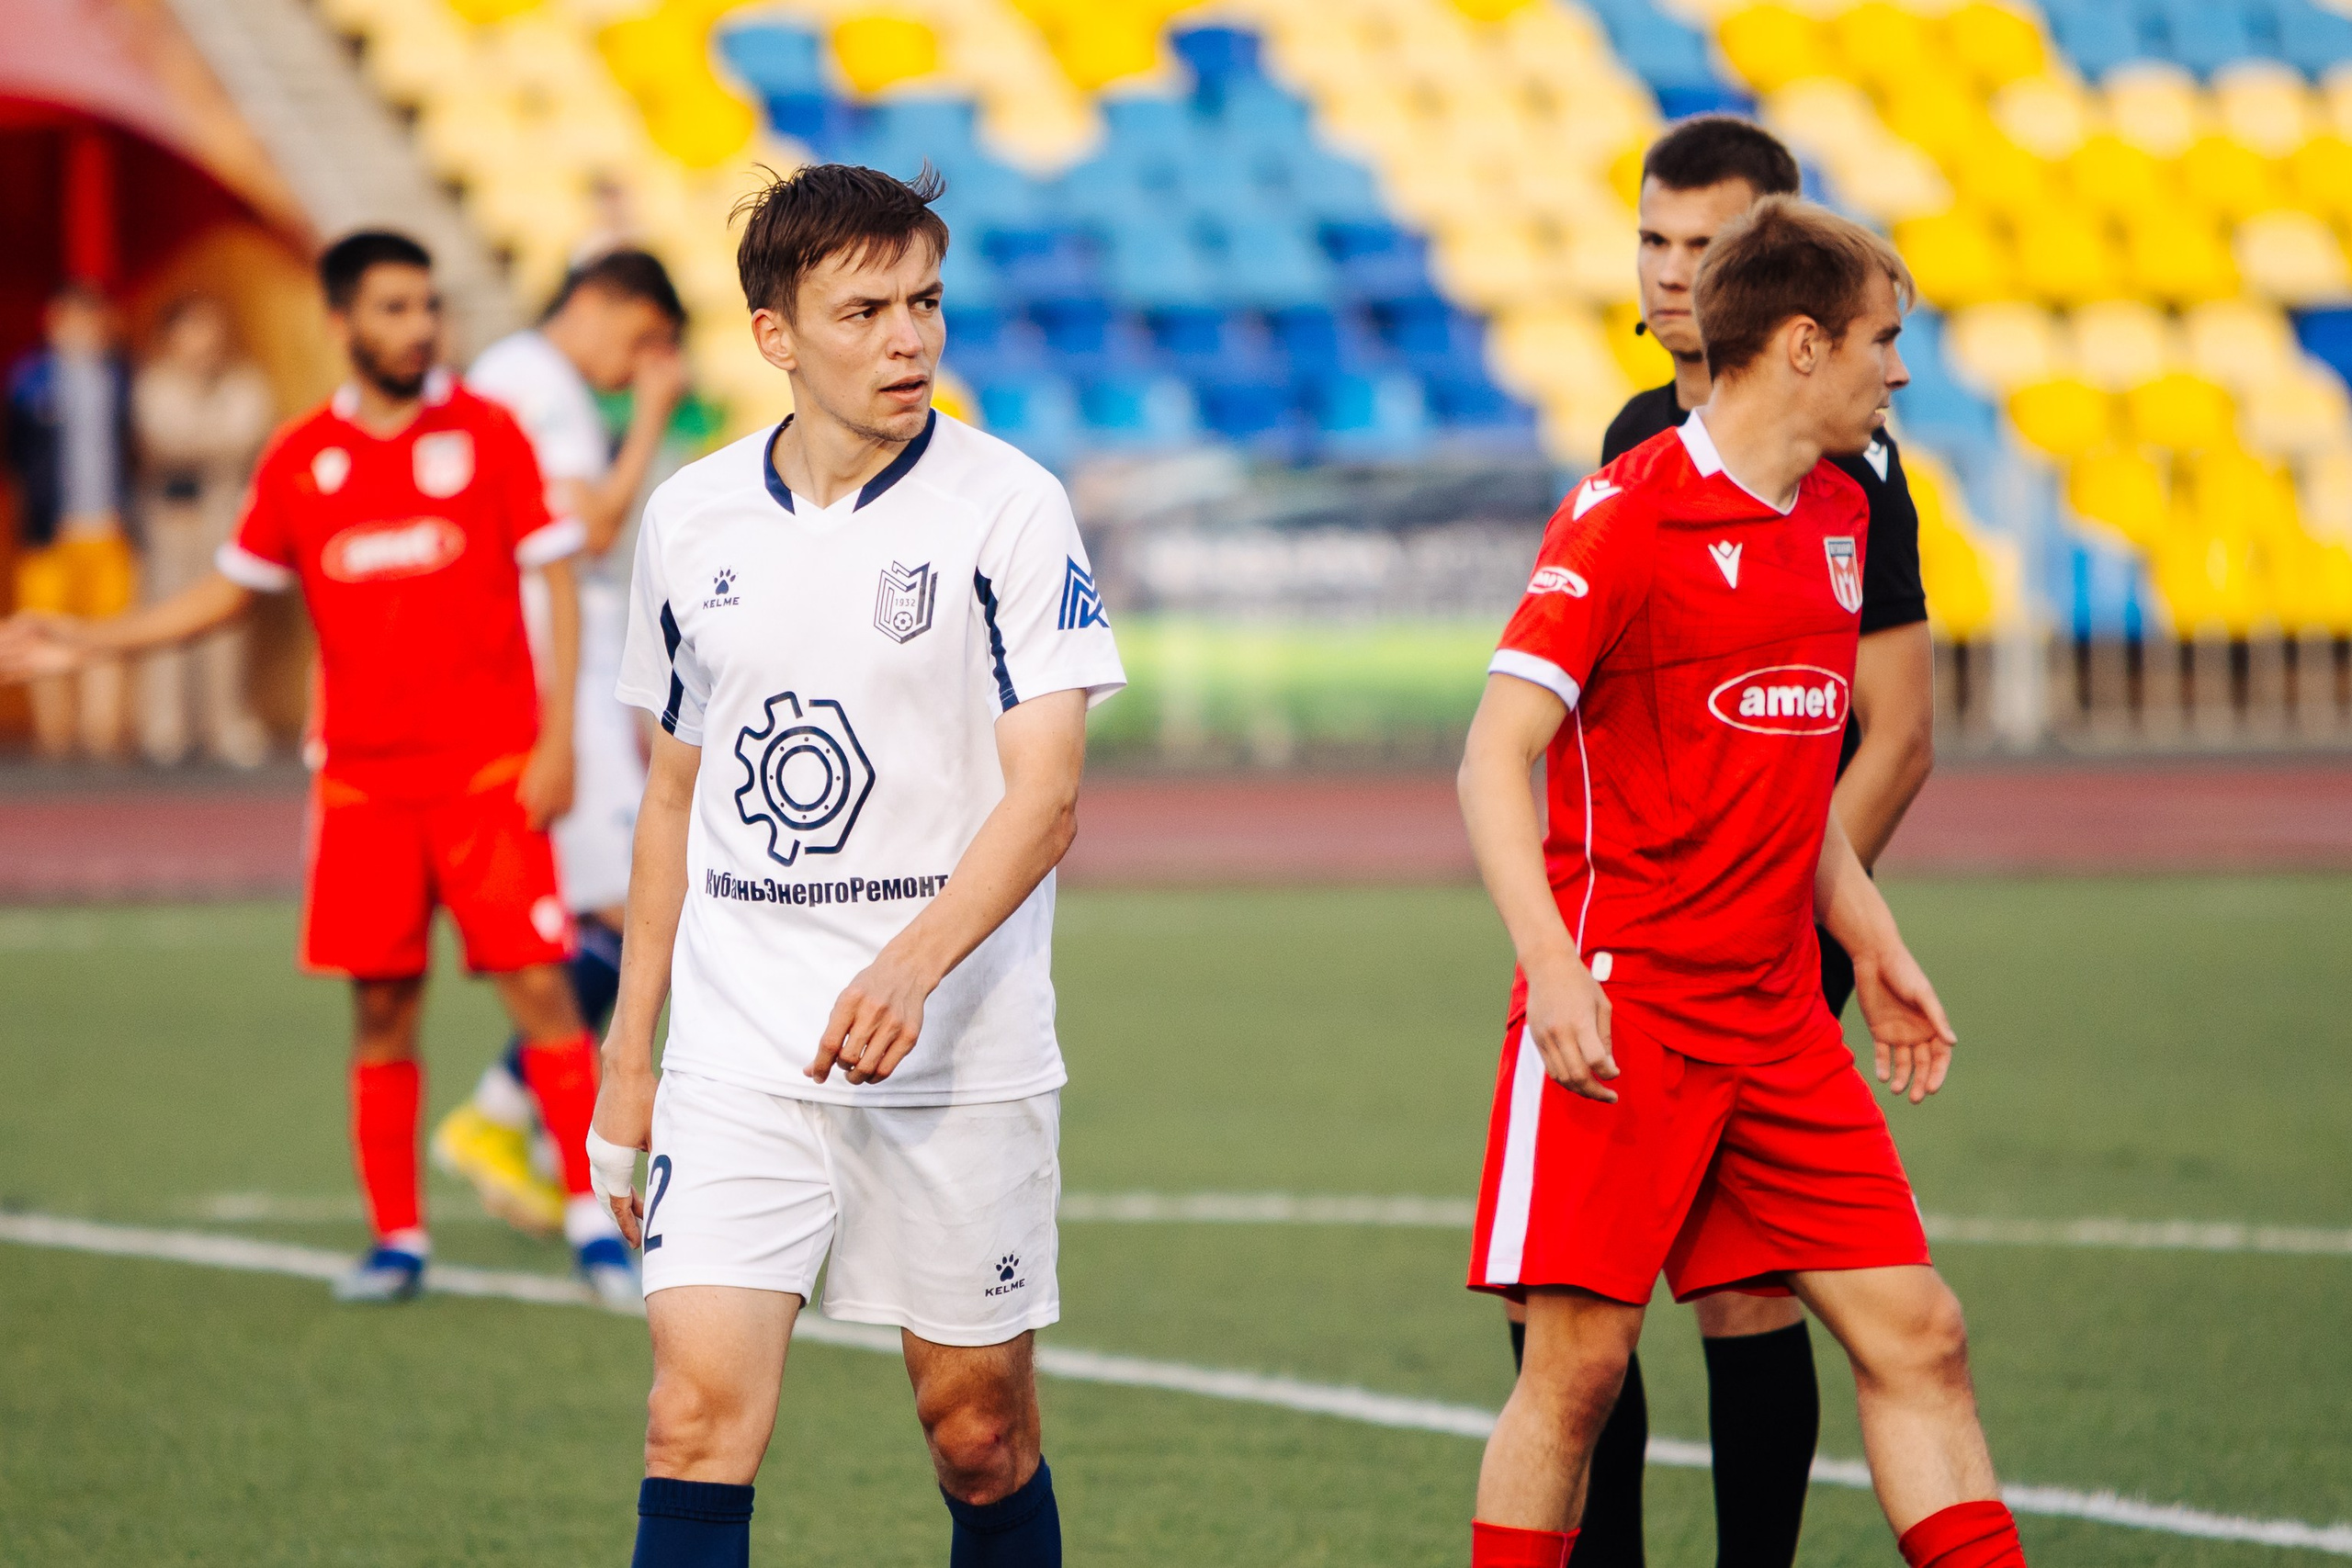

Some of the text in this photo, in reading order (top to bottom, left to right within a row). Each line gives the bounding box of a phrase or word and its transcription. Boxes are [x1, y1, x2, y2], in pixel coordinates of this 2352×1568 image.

[703, 597, 740, 610] KELME
[896, 598, 916, 607] 1932
[1739, 680, 1837, 719] amet
[706, 868, 948, 908] КубаньЭнергоРемонт
[644, 1154, 672, 1256] 2
[985, 1278, 1025, 1297] KELME
